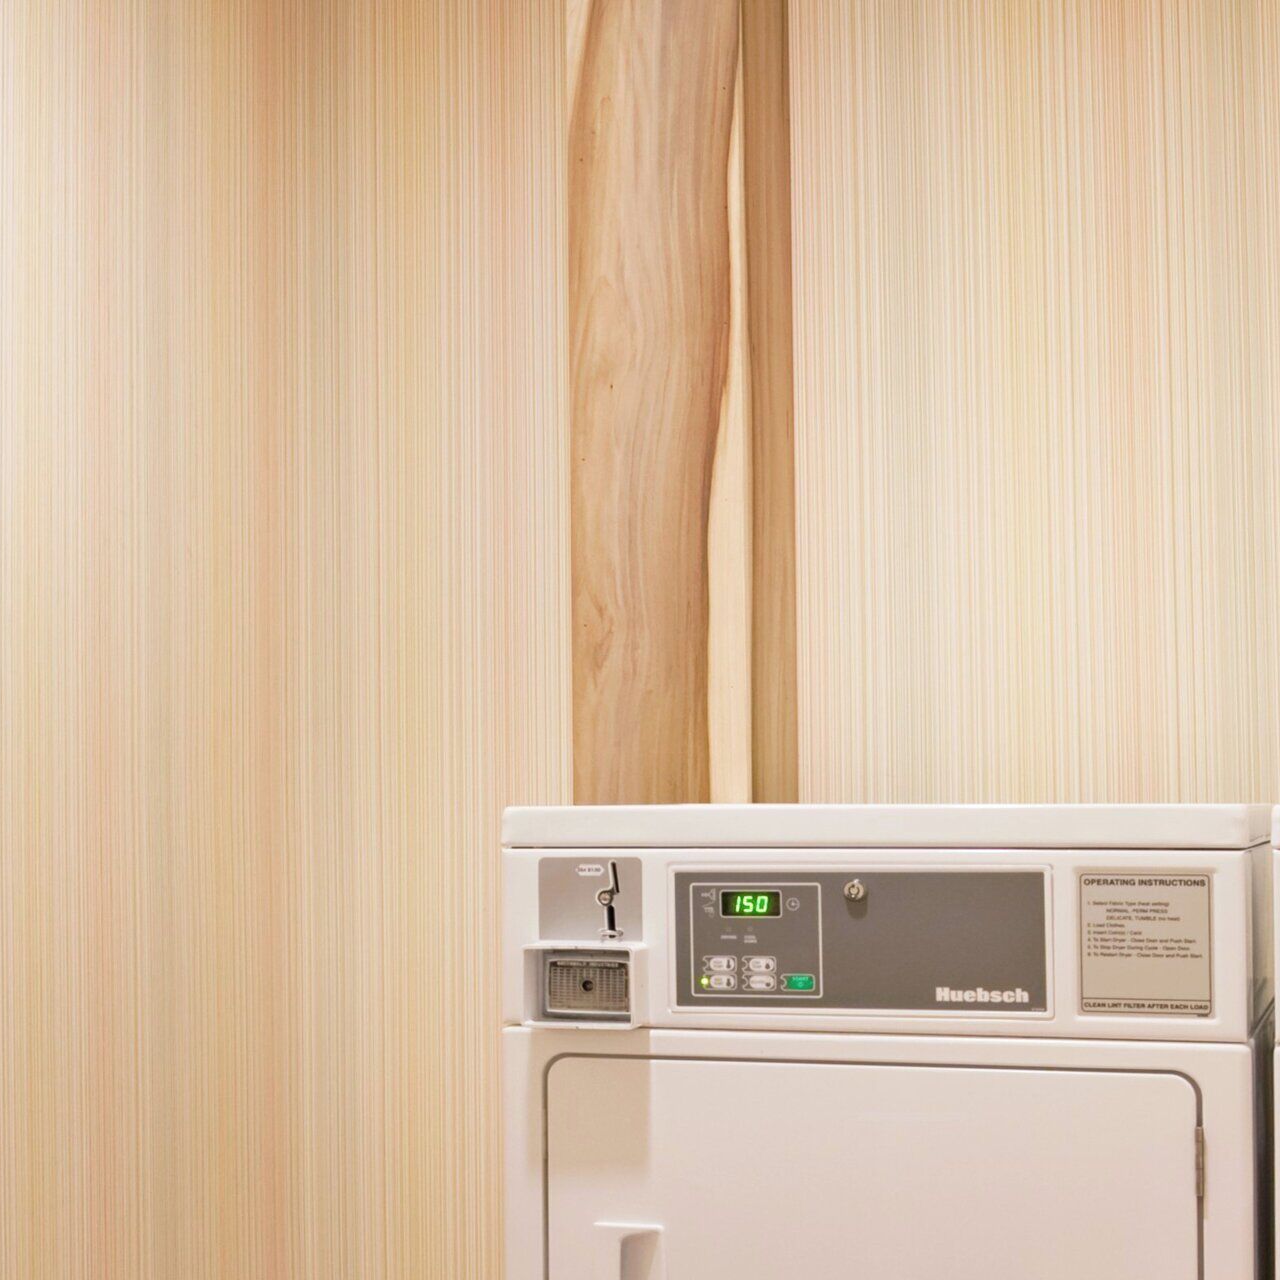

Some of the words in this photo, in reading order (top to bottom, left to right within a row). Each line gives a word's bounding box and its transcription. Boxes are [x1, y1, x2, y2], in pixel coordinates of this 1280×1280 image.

[1083, 878, 1136, 886] OPERATING
[1138, 879, 1206, 887] INSTRUCTIONS
[735, 895, 769, 913] 150
[936, 987, 1030, 1003] Huebsch
